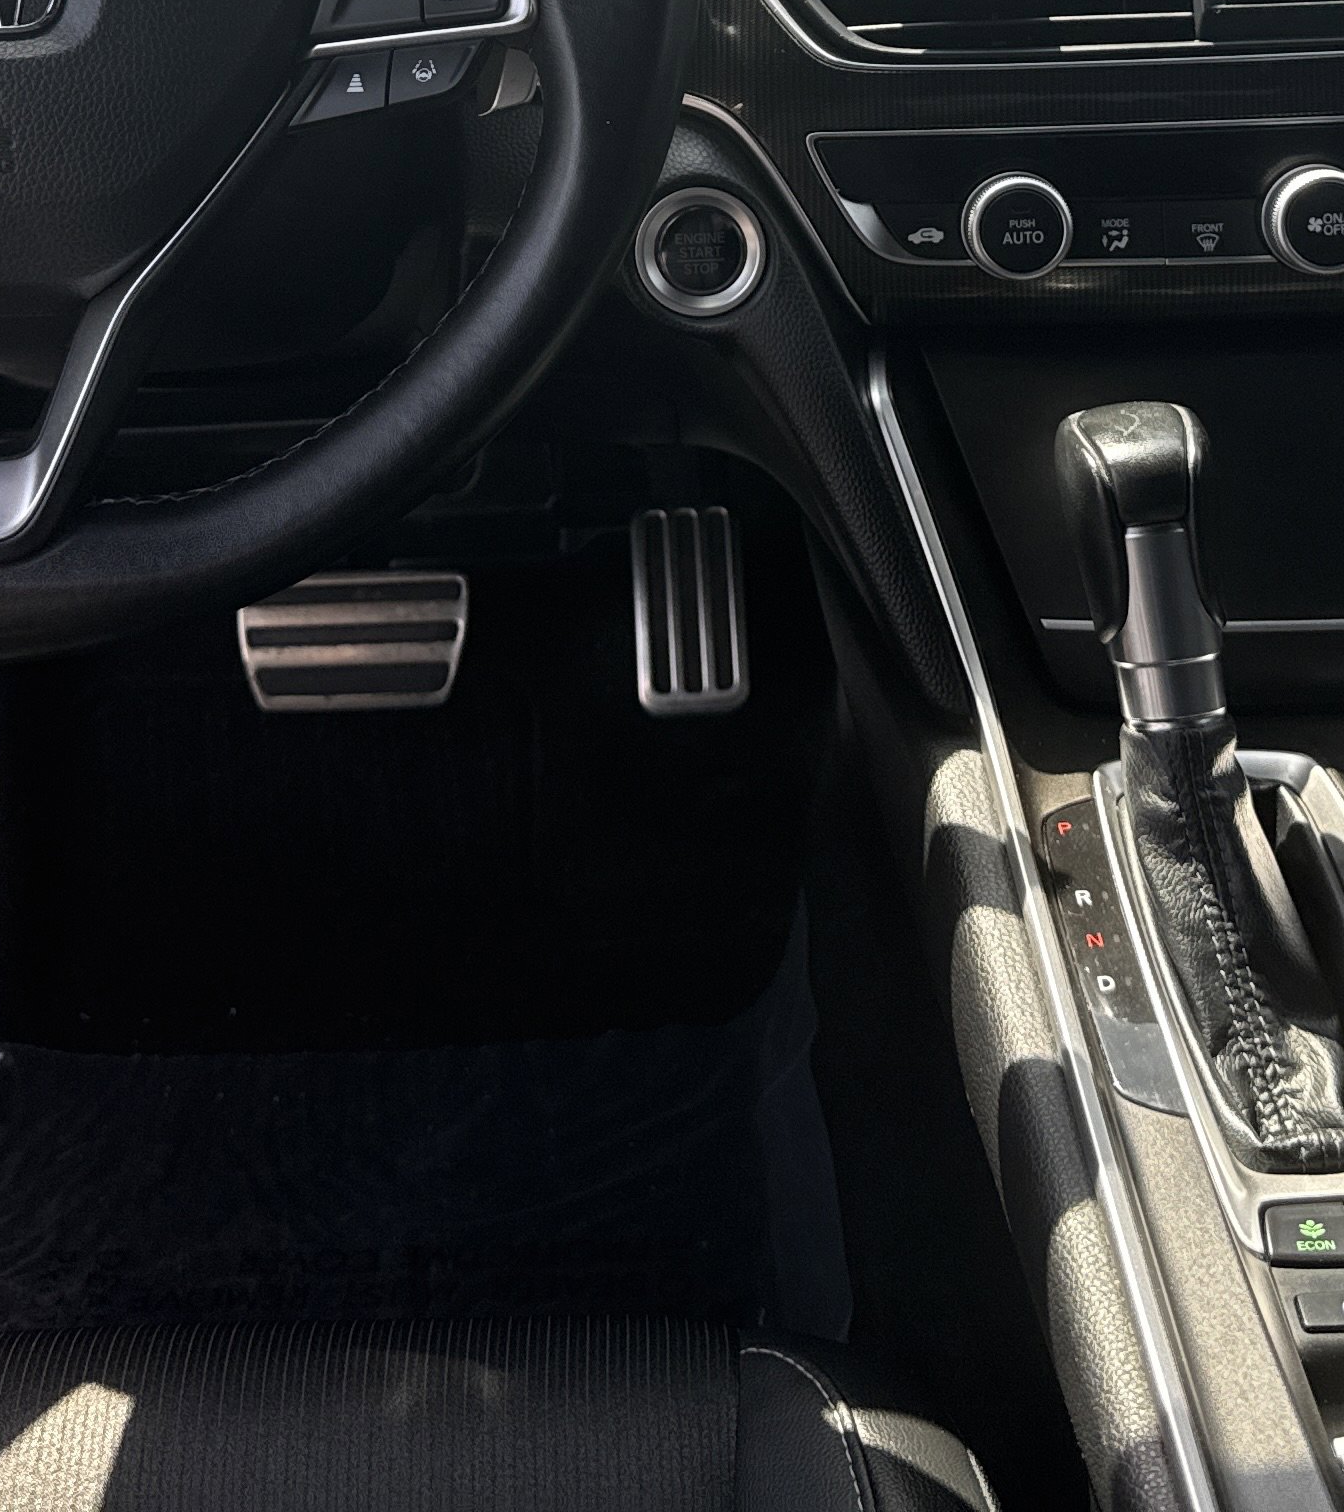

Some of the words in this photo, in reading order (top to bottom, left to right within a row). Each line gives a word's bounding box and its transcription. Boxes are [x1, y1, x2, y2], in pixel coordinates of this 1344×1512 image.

[1009, 219, 1036, 230] PUSH
[1101, 218, 1129, 229] MODE
[1191, 223, 1224, 234] FRONT
[674, 231, 726, 246] ENGINE
[1002, 231, 1045, 246] AUTO
[679, 246, 722, 259] START
[683, 261, 719, 276] STOP
[1057, 821, 1072, 836] P
[1074, 889, 1093, 907] R
[1085, 932, 1105, 948] N
[1096, 975, 1116, 993] D
[1295, 1239, 1337, 1252] ECON
